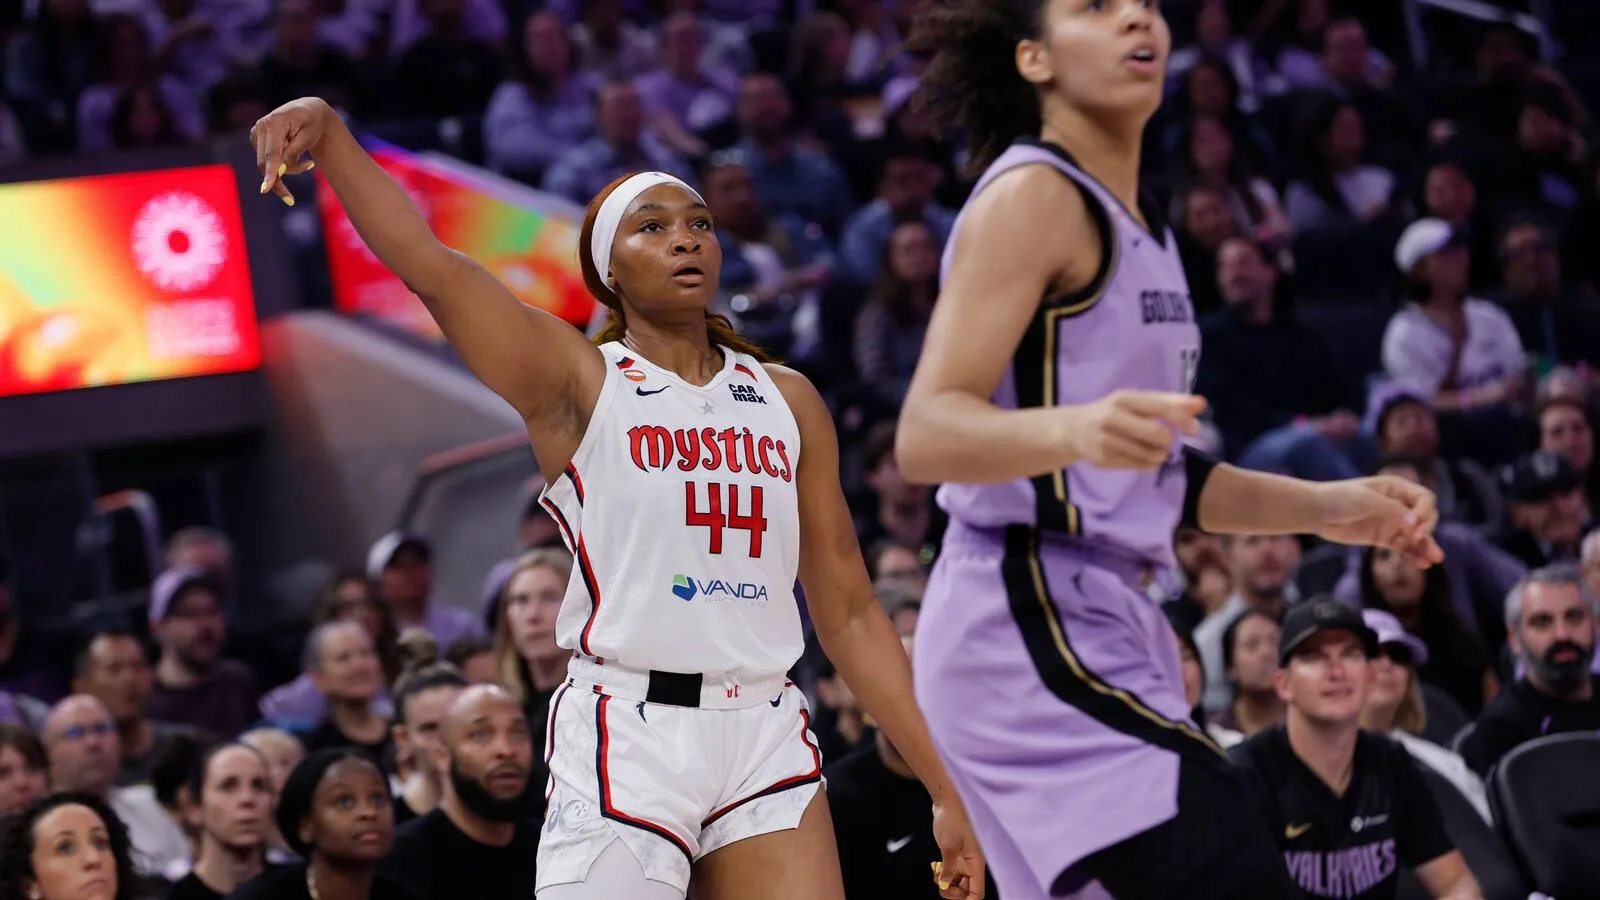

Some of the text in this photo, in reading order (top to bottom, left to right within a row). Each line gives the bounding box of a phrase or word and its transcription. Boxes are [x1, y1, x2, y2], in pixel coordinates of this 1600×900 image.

[728, 383, 757, 394] CAR
[732, 392, 768, 405] max
[685, 481, 767, 558] 44
[697, 579, 768, 601] VANDA
[1284, 838, 1396, 899] VALKYRIES
